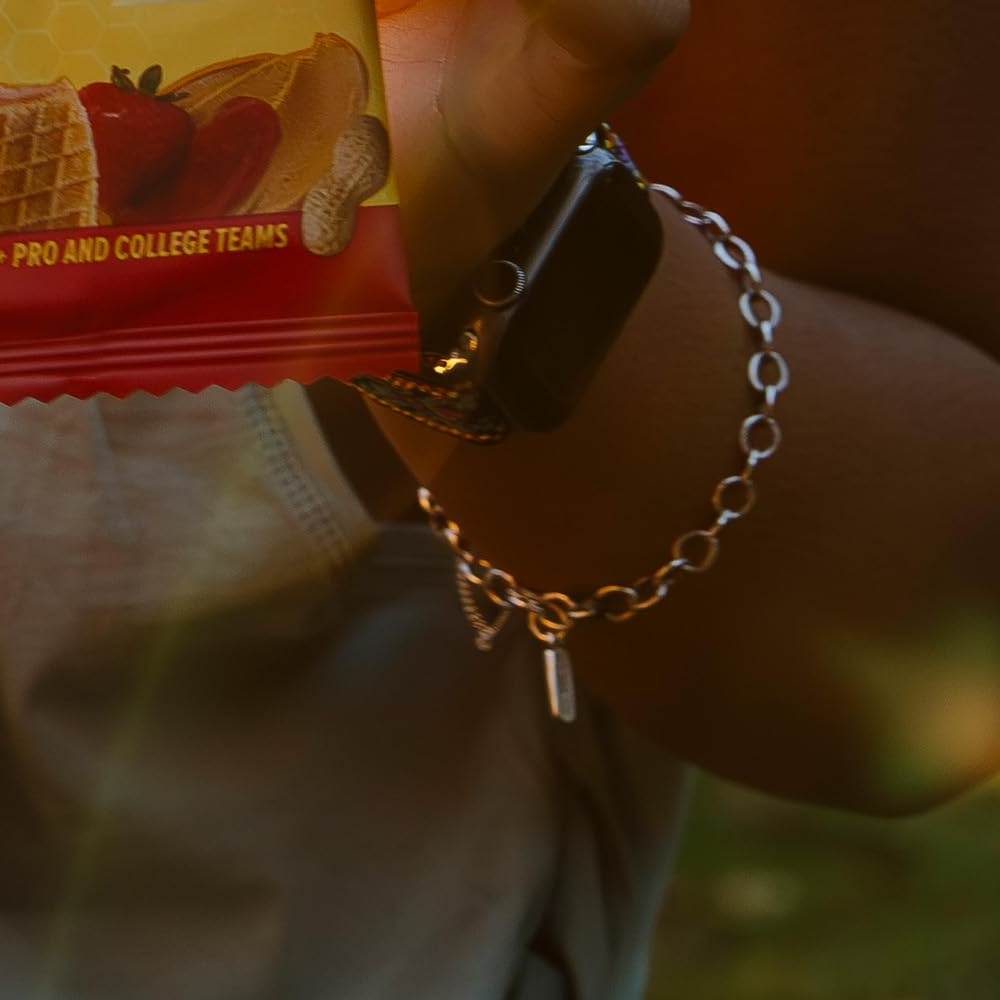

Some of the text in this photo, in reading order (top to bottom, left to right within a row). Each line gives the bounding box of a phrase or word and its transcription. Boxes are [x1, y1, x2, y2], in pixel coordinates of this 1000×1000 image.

[11, 241, 59, 268] PRO
[62, 237, 110, 264] AND
[114, 229, 211, 260] COLLEGE
[215, 224, 289, 253] TEAMS
